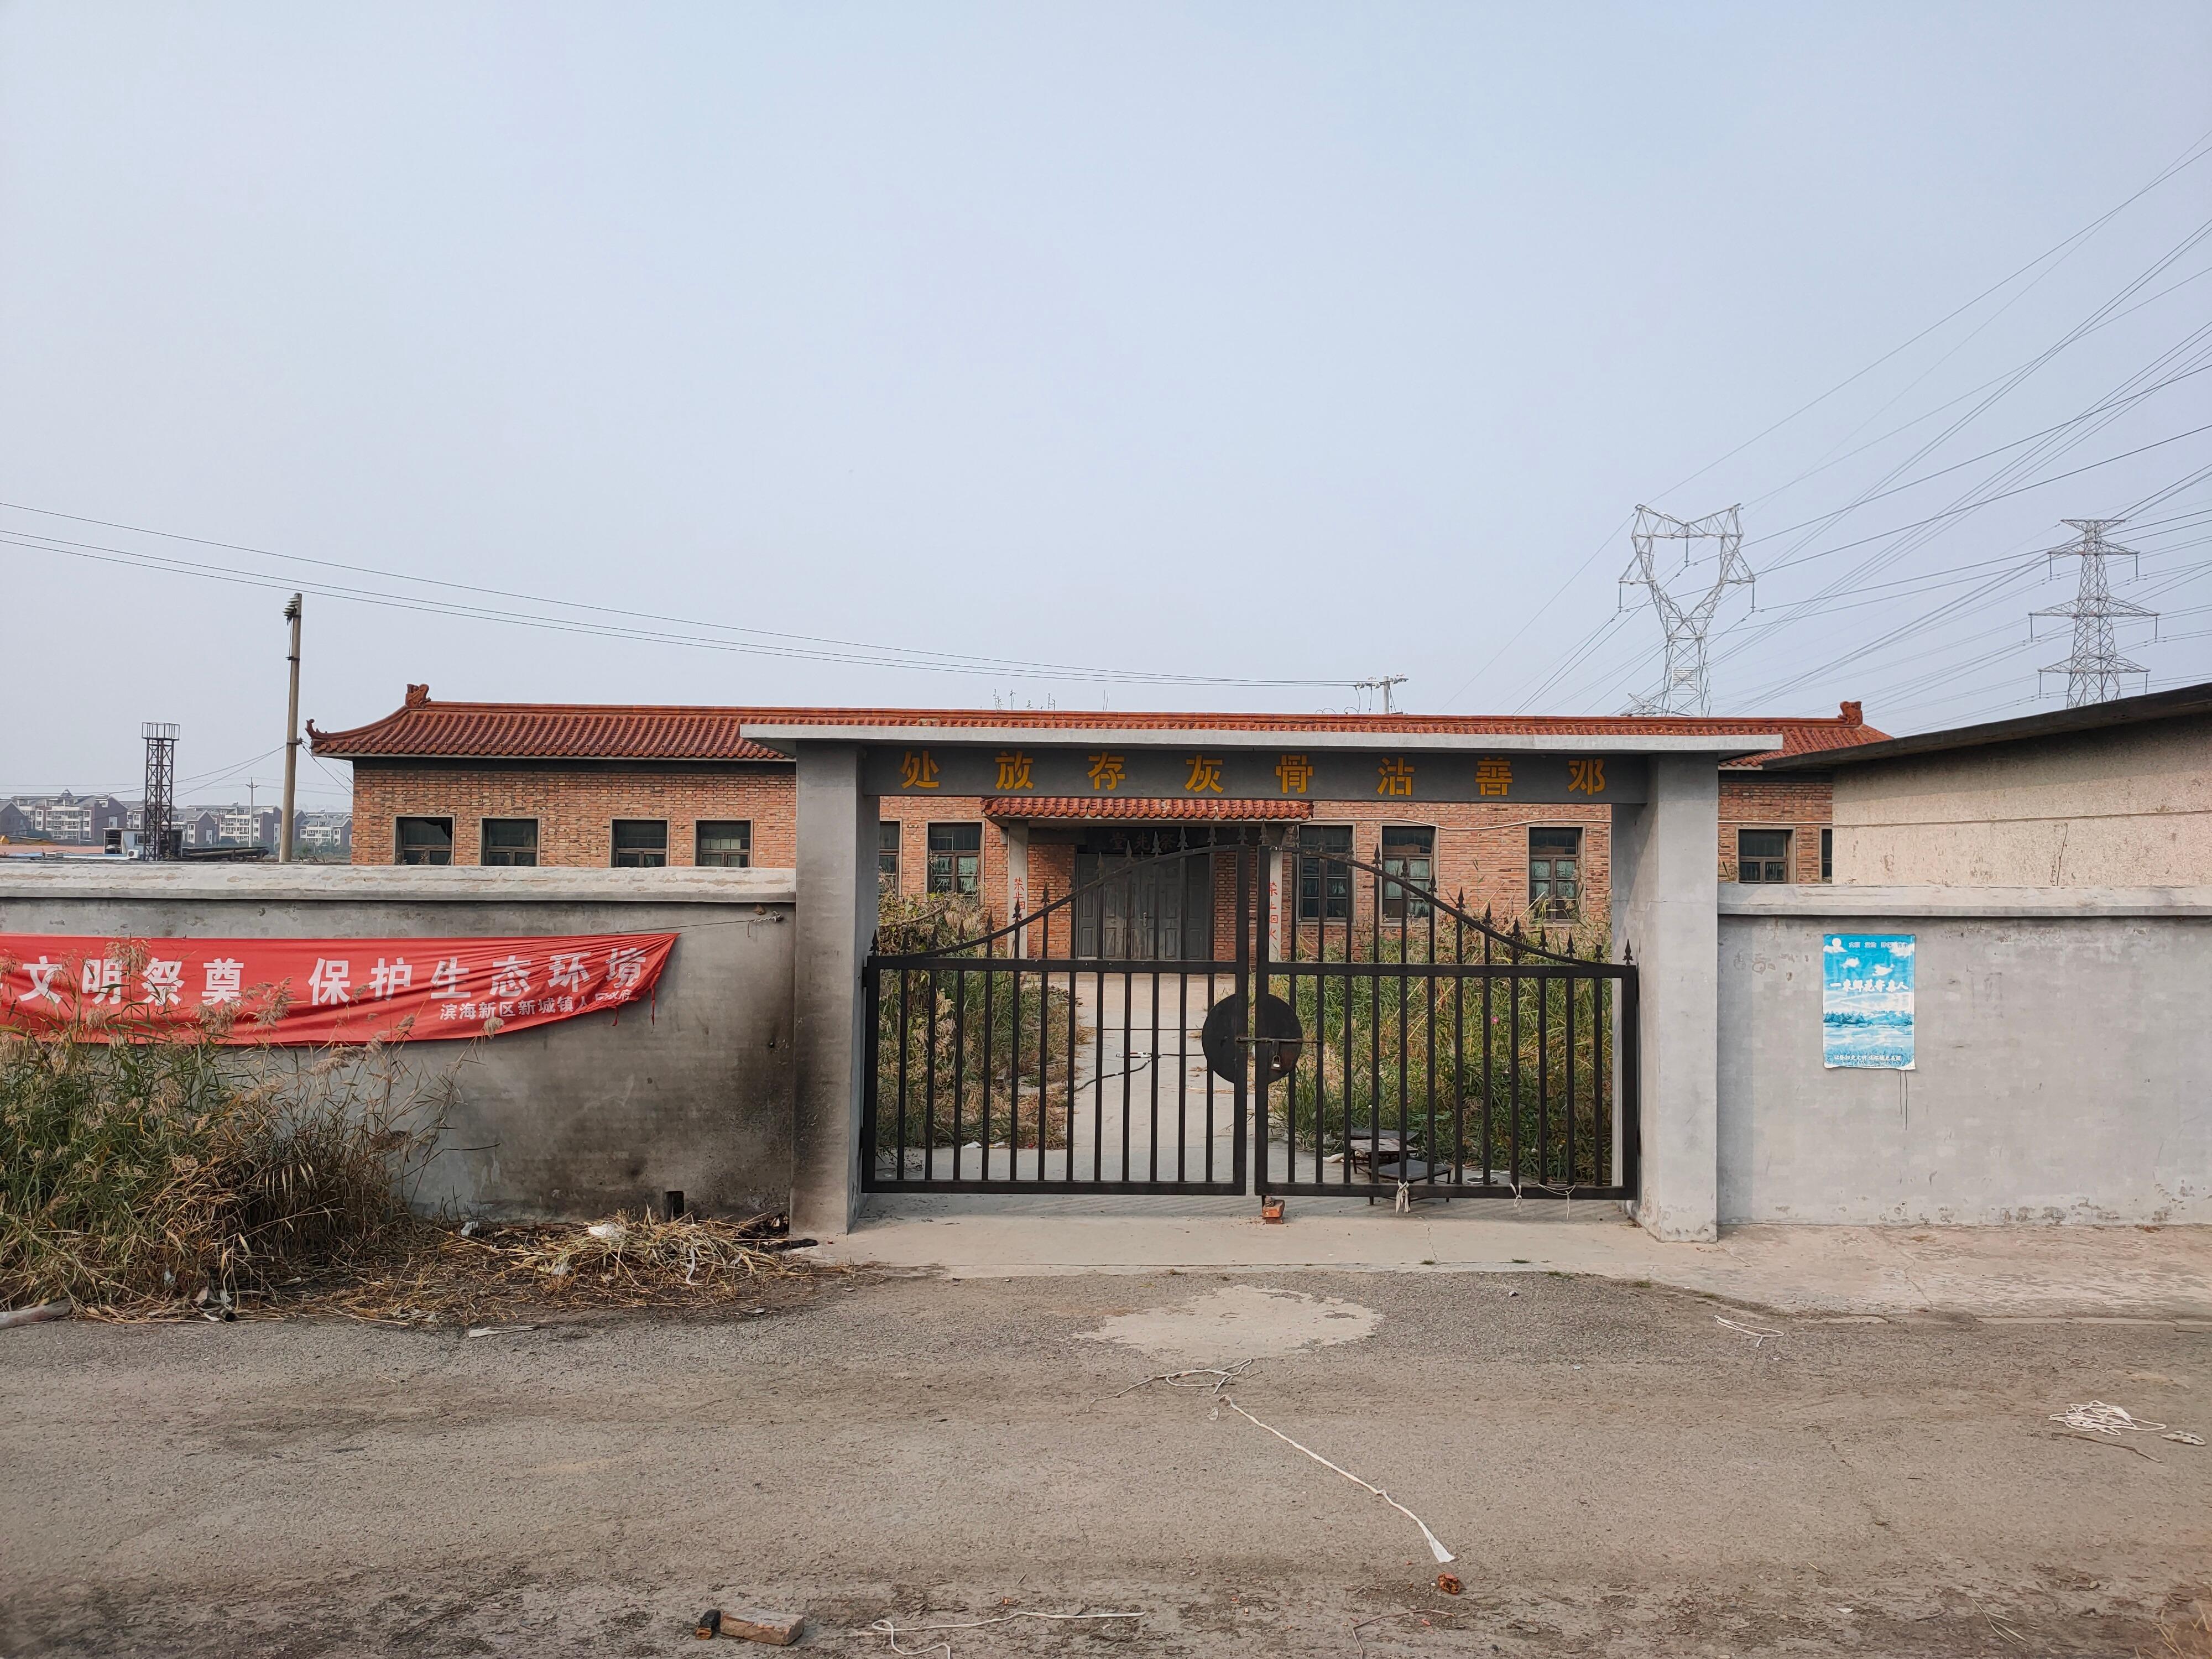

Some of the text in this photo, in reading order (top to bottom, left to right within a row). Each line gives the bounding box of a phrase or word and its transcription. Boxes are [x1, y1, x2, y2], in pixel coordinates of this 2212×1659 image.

[18, 947, 646, 1006] 文明祭奠 保护生态环境
